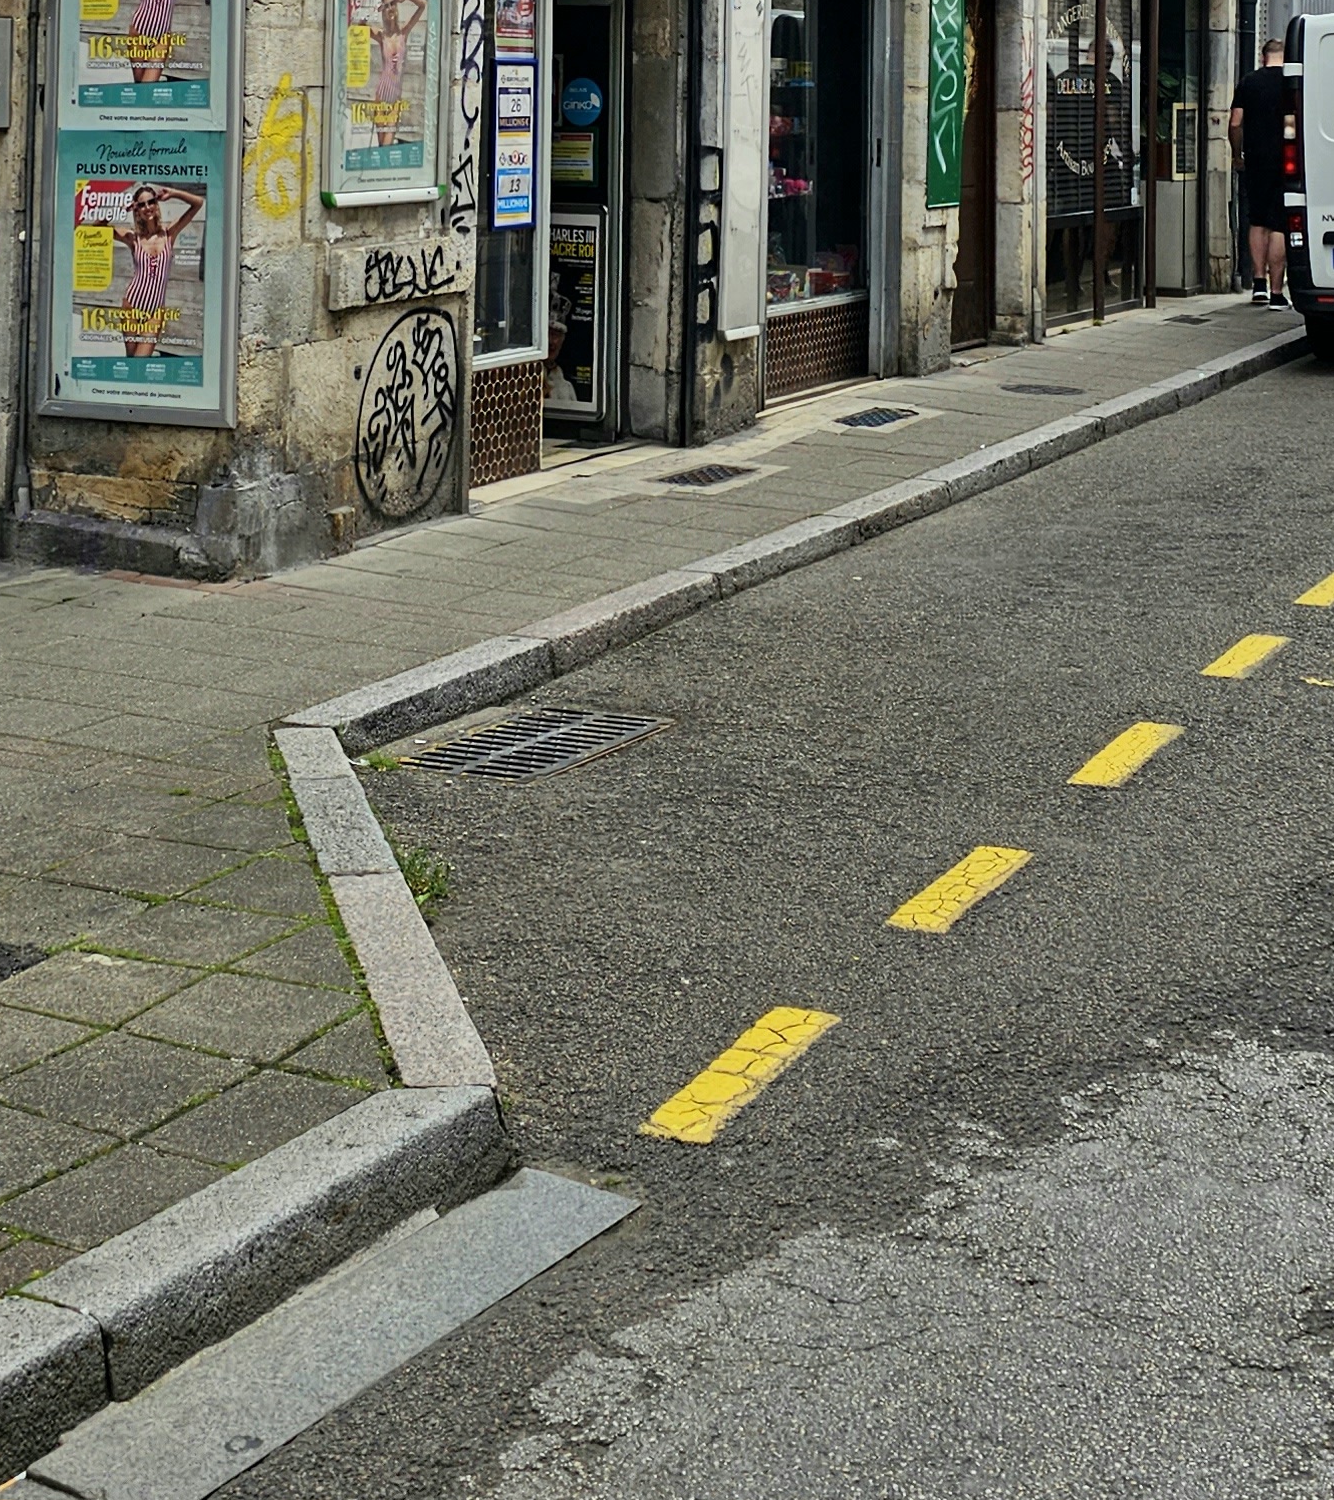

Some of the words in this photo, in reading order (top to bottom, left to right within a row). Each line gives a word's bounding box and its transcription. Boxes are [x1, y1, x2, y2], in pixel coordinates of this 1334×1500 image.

[115, 34, 158, 45] recettes
[160, 32, 187, 45] d'été
[88, 35, 113, 60] 16
[511, 98, 521, 113] 26
[351, 103, 366, 124] 16
[96, 141, 147, 161] Nouvelle
[148, 138, 187, 160] formule
[76, 163, 106, 175] PLUS
[110, 164, 208, 177] DIVERTISSANTE!
[509, 178, 521, 193] 13
[80, 185, 134, 206] Femme
[79, 206, 127, 221] Actuelle
[550, 229, 585, 243] HARLES
[579, 243, 594, 258] ROI
[81, 308, 106, 332] 16
[108, 308, 152, 320] recettes
[153, 307, 181, 321] d'été
